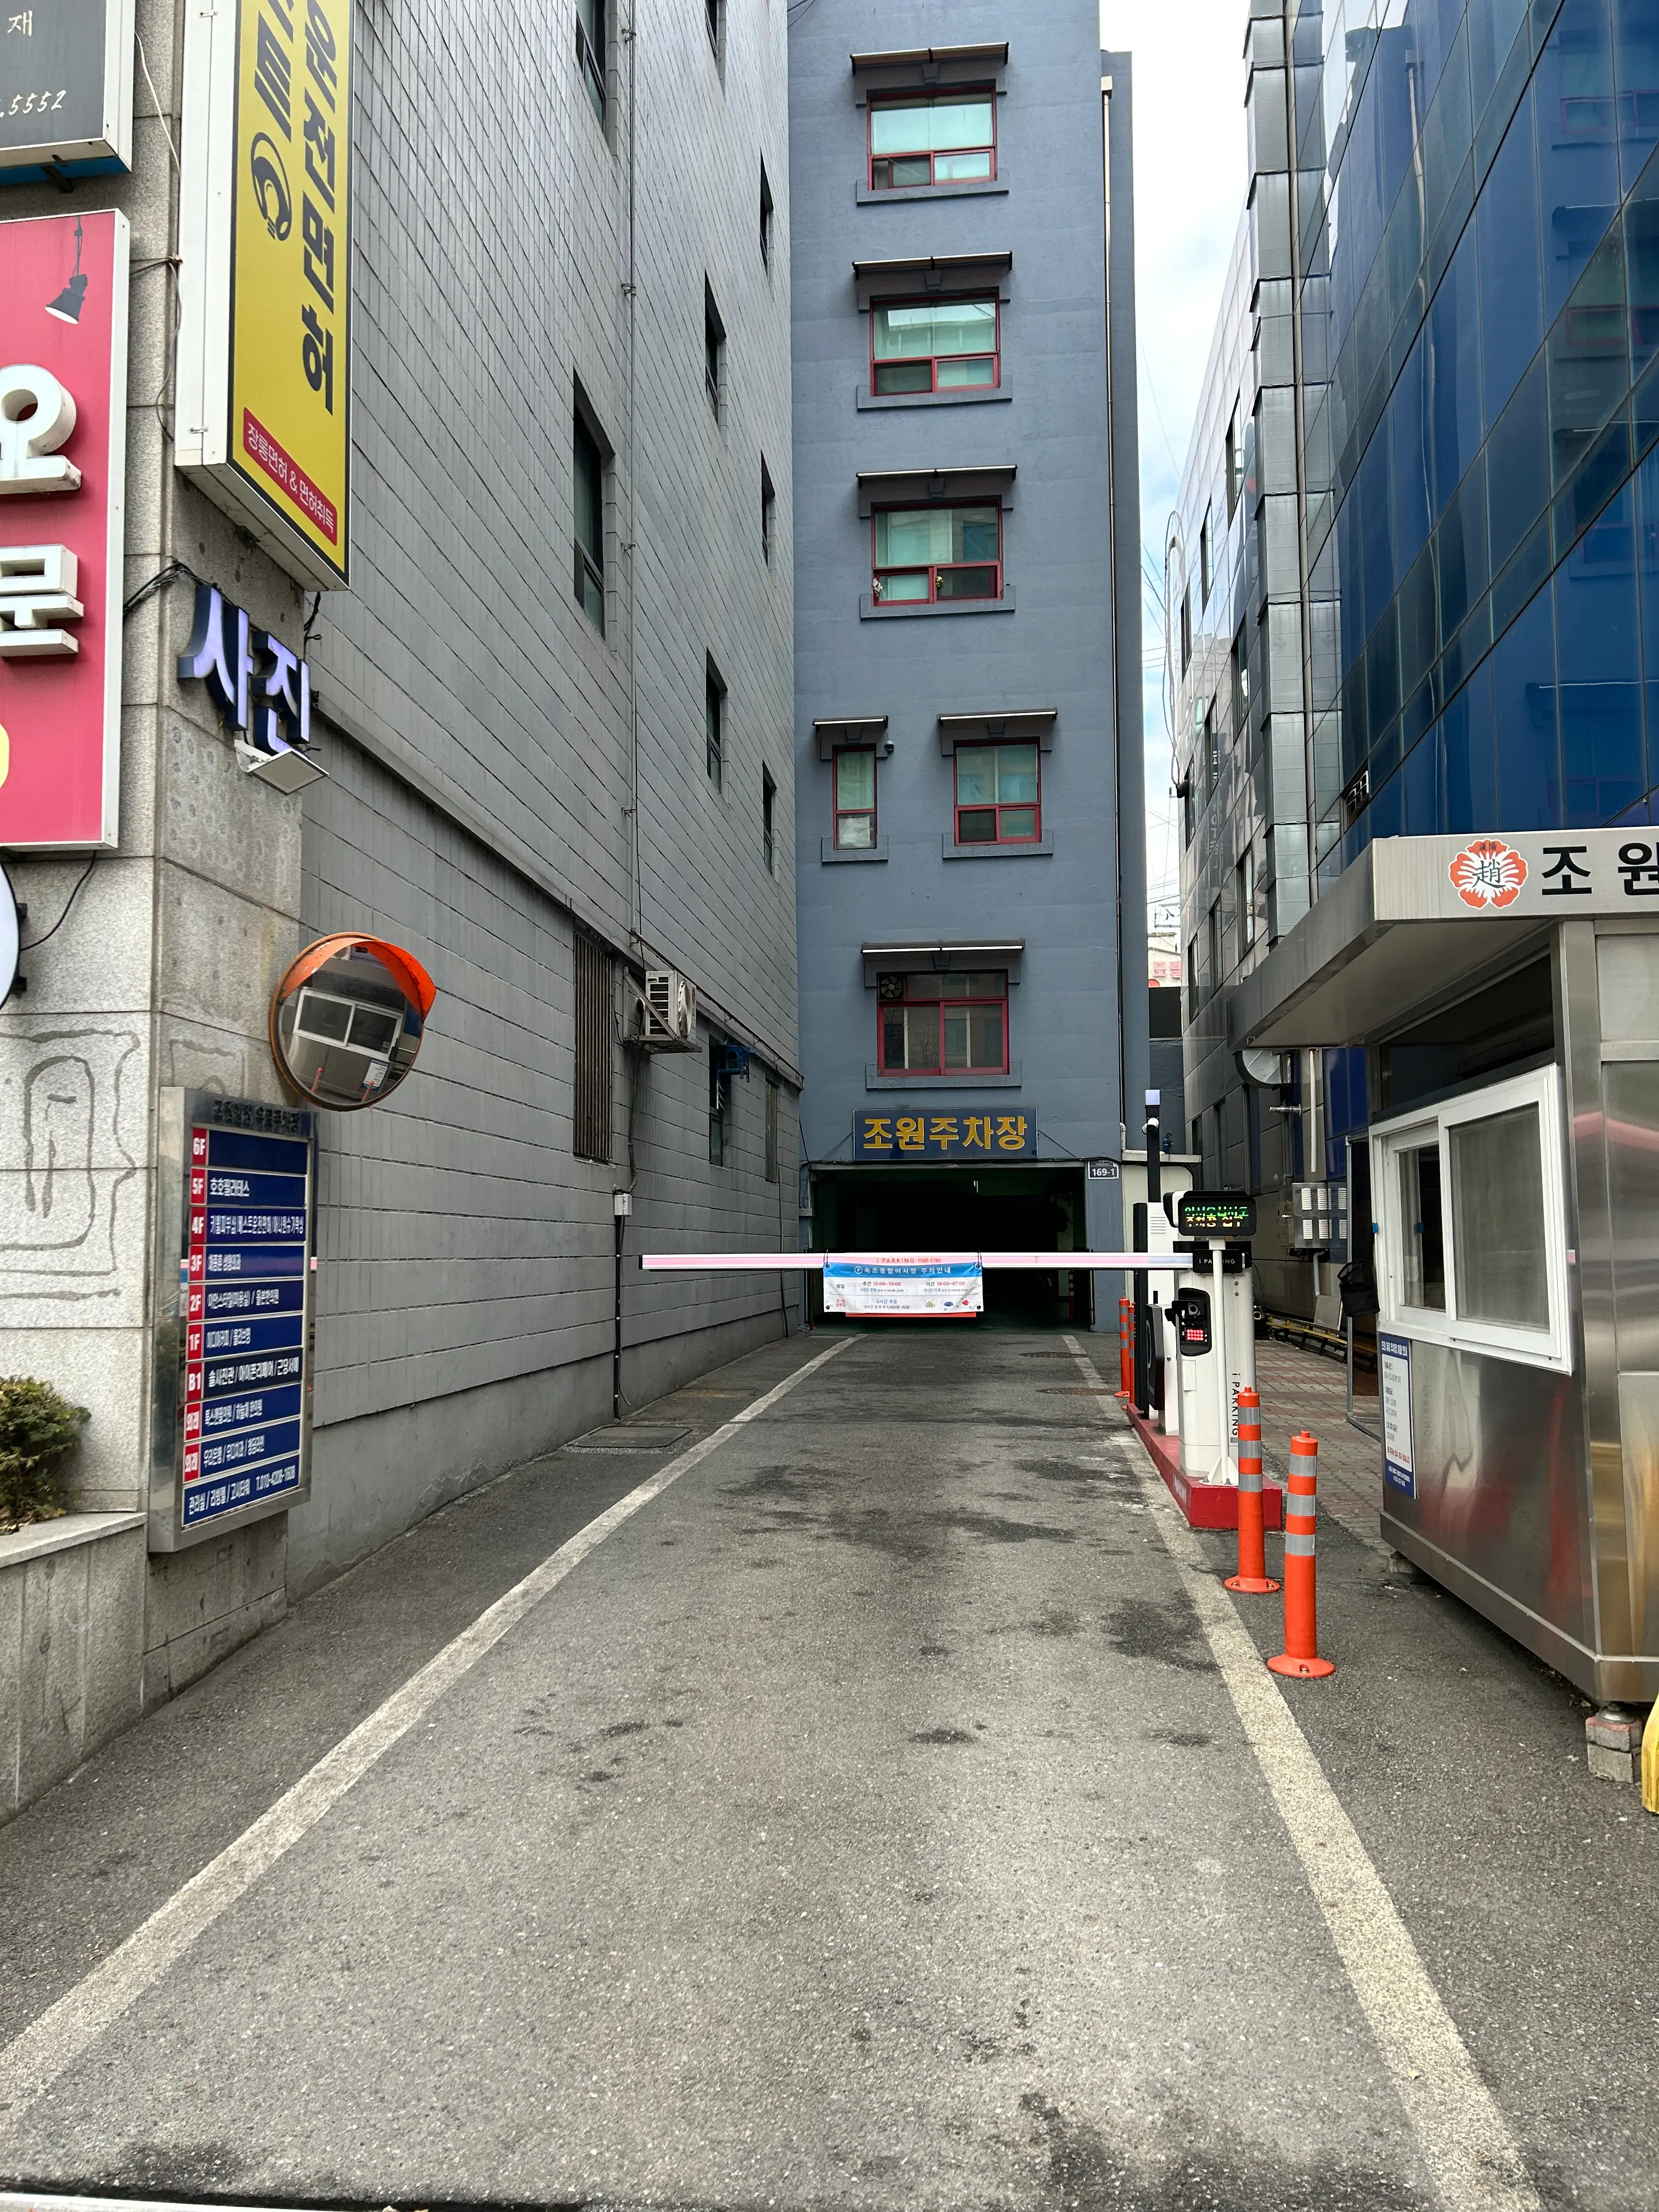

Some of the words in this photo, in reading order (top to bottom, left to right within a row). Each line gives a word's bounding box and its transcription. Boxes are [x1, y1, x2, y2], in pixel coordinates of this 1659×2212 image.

[248, 422, 287, 483] 장롱면허
[289, 470, 298, 494] &
[300, 479, 334, 534] 면허취득
[177, 584, 311, 759] 사진
[862, 1115, 1029, 1150] 조원주차장
[193, 1138, 206, 1155] 6F
[1092, 1168, 1115, 1176] 169-1
[192, 1178, 204, 1195] 5F
[191, 1216, 204, 1234] 4F
[190, 1254, 202, 1271] 3F
[190, 1294, 201, 1312] 2F
[189, 1334, 200, 1351] 1F
[188, 1374, 201, 1391] B1
